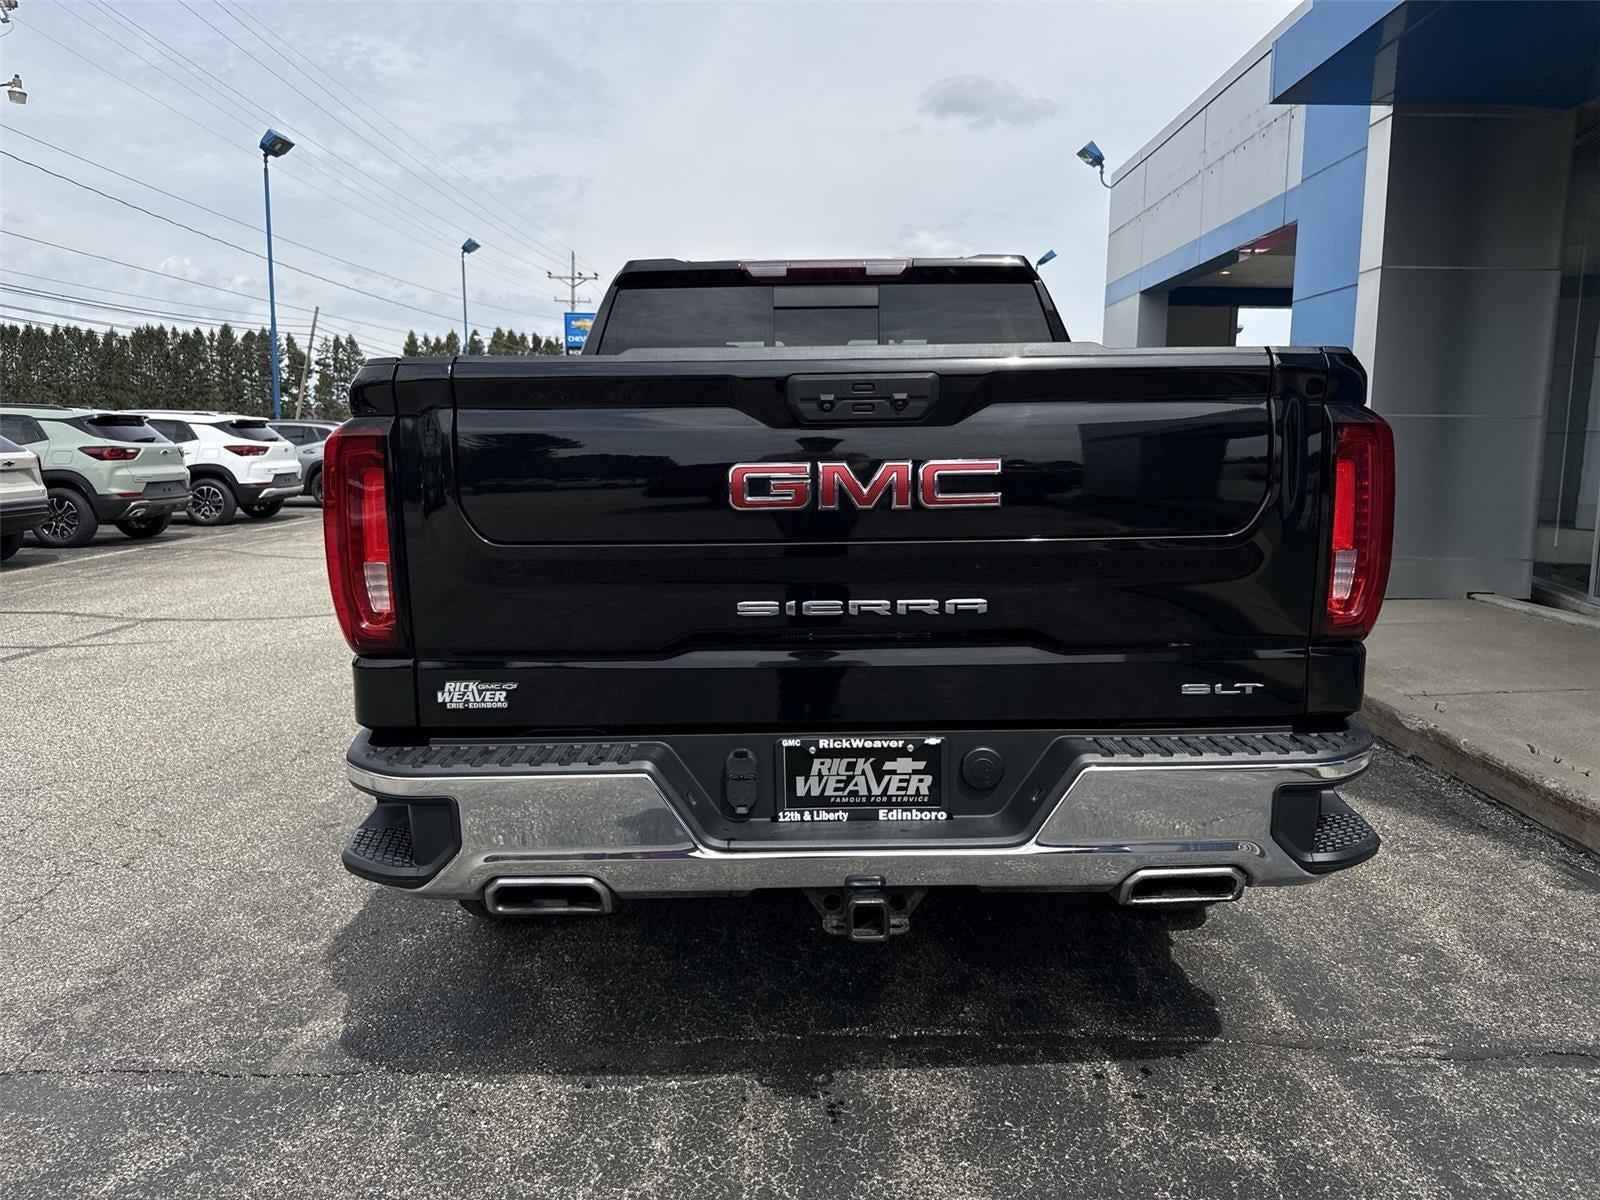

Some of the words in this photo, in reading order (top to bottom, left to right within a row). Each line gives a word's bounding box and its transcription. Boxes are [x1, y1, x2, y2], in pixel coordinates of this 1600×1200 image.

[729, 459, 1002, 511] GMC
[736, 598, 988, 616] SIERRA
[444, 682, 478, 692] RICK
[1181, 683, 1264, 695] SLT
[437, 691, 506, 702] WEAVER
[782, 739, 801, 747] GMC
[819, 739, 904, 749] RickWeaver
[810, 757, 876, 776] RICK
[795, 775, 933, 797] WEAVER
[778, 811, 801, 822] 12th
[803, 811, 811, 821] &
[813, 810, 849, 822] Liberty
[878, 809, 947, 821] Edinboro
